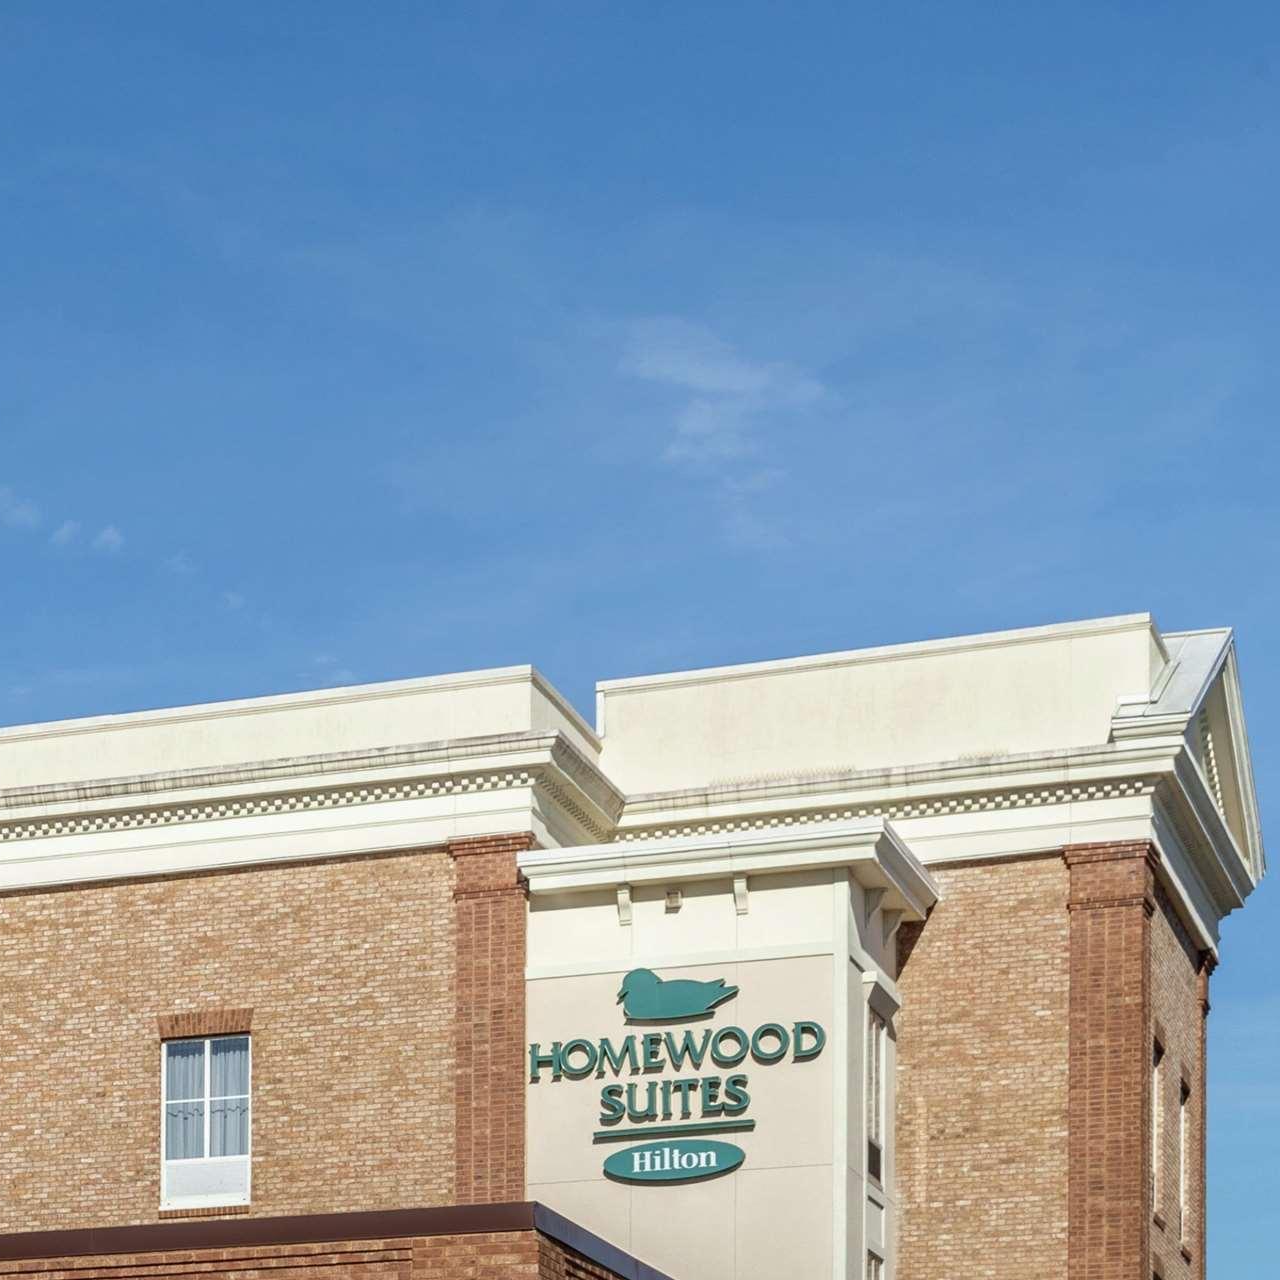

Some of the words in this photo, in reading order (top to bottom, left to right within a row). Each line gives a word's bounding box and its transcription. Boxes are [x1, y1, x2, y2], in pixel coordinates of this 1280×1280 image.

[529, 1021, 826, 1083] HOMEWOOD
[599, 1074, 751, 1126] SUITES
[631, 1147, 717, 1173] Hilton
